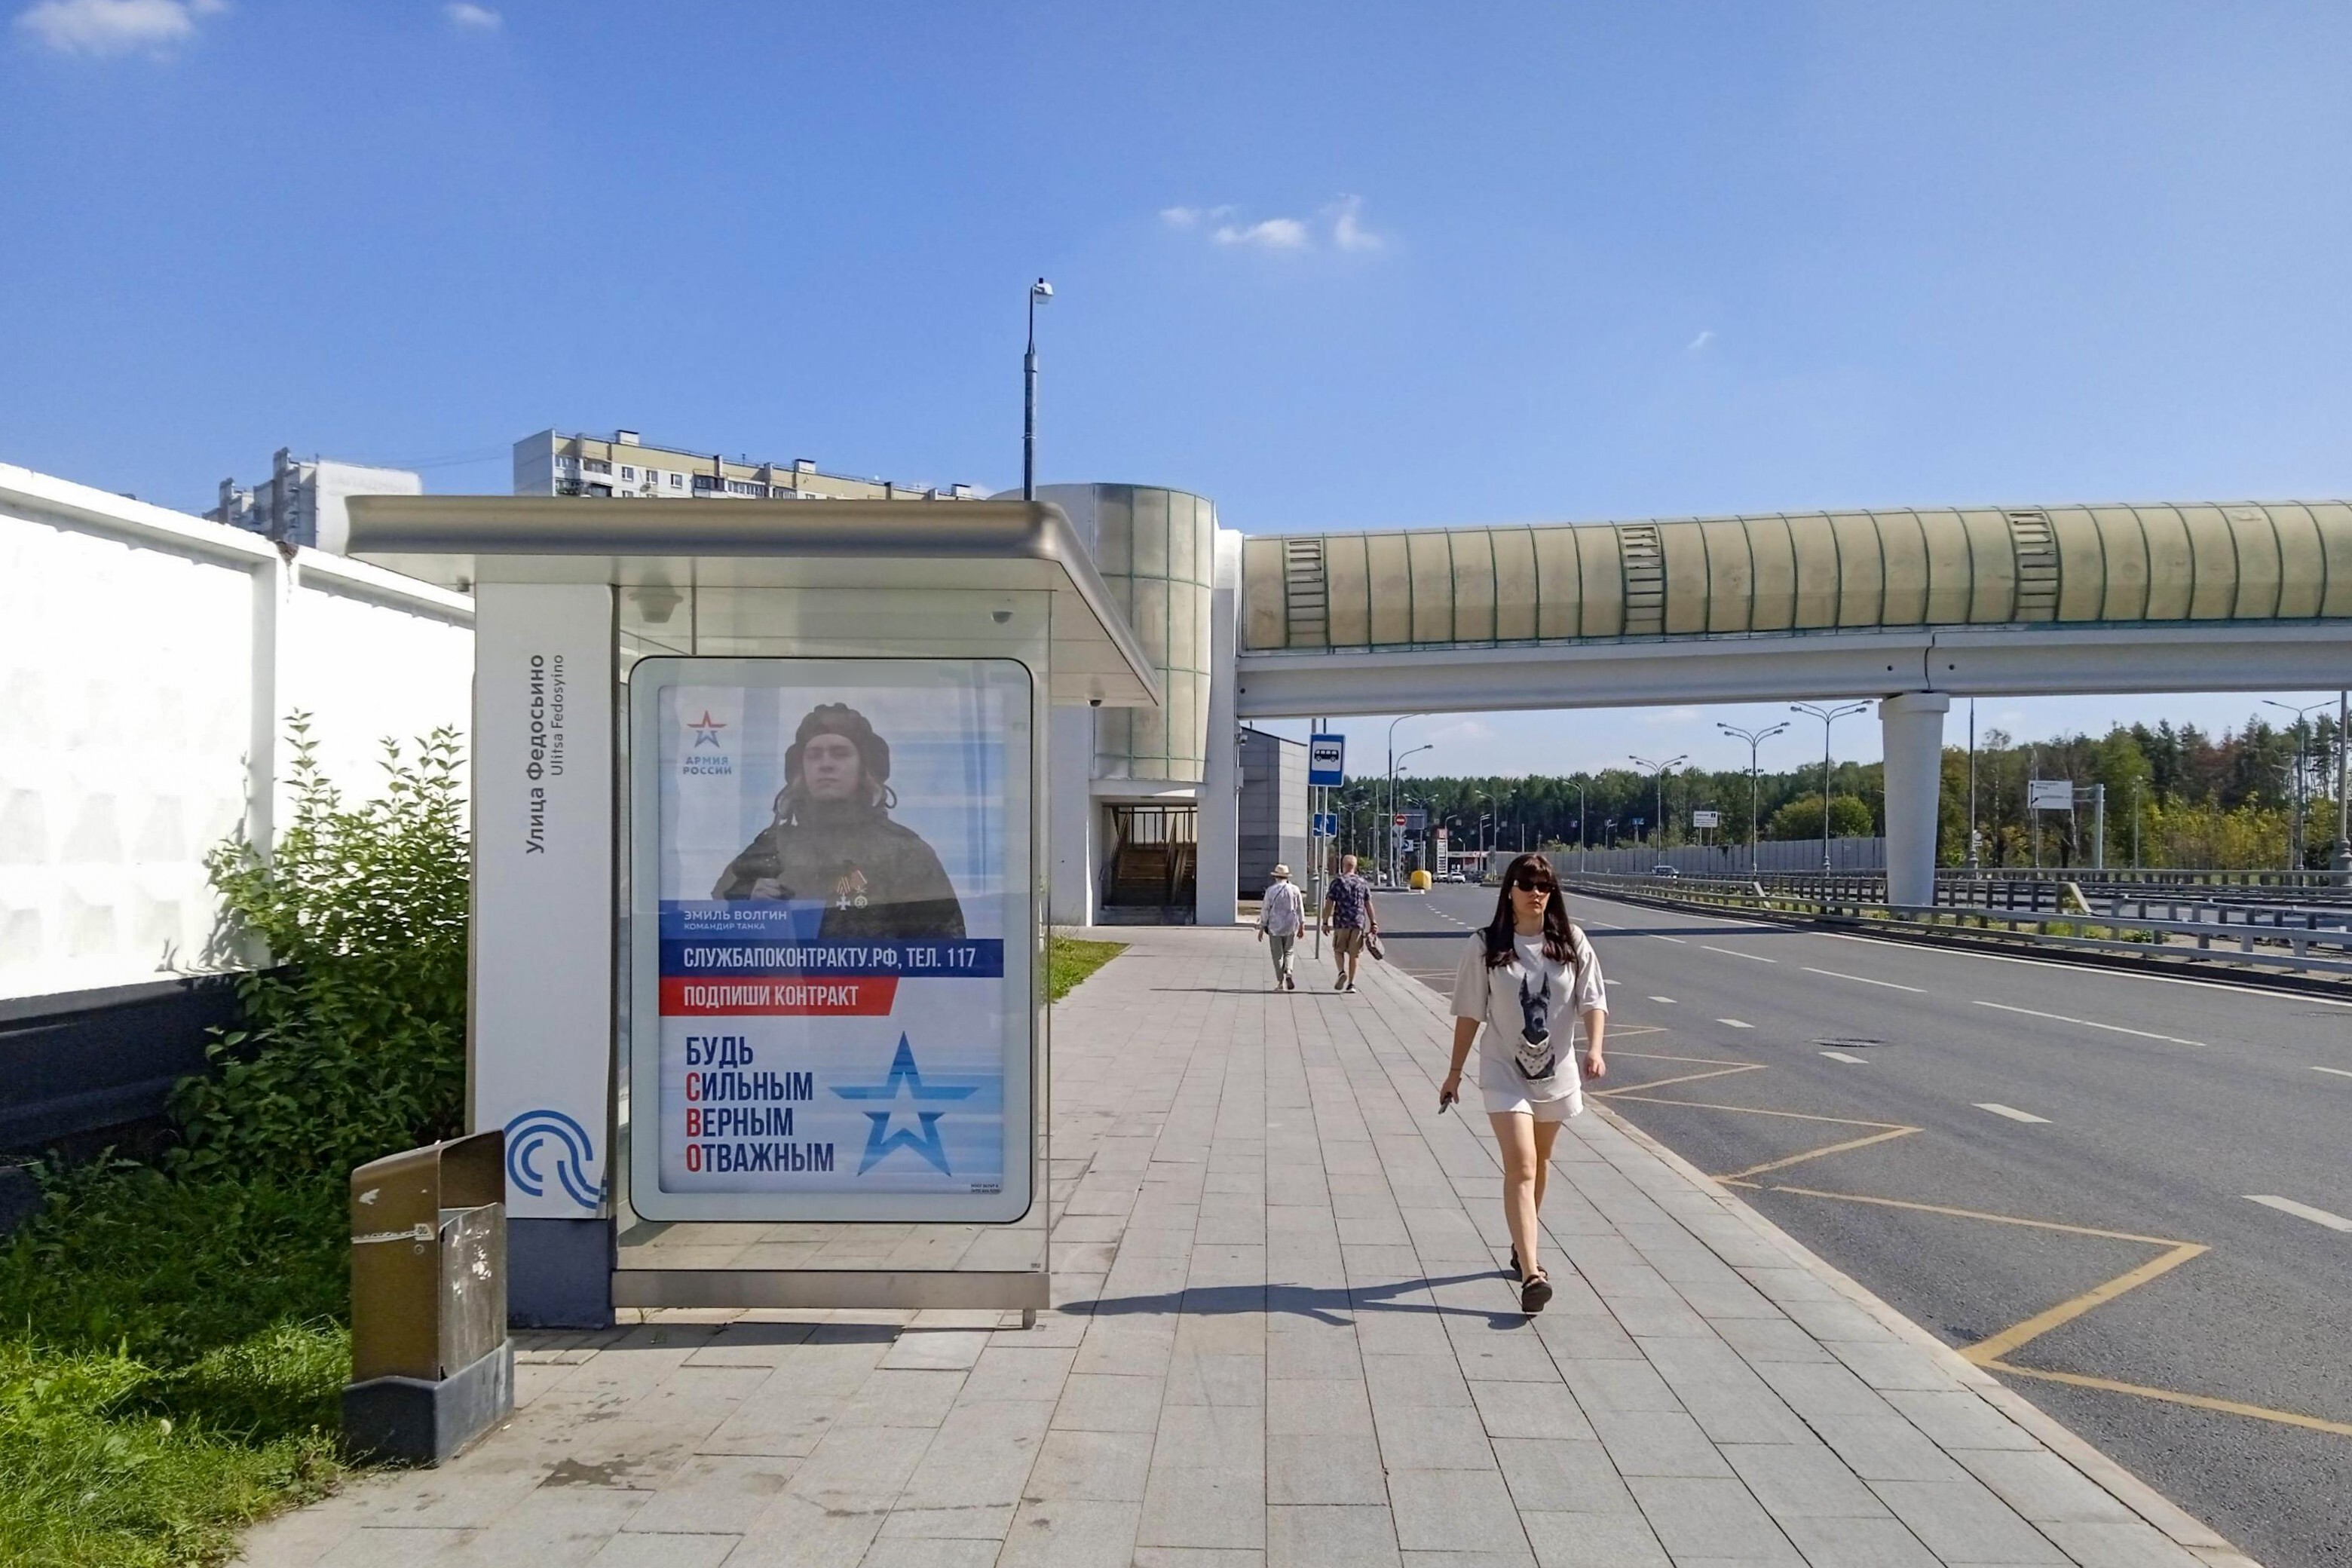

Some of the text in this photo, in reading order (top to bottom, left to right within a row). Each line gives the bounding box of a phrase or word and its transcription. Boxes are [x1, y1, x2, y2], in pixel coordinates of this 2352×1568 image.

[550, 654, 566, 776] Ulitsa Fedosyino
[525, 654, 547, 854] Улица Федосьино
[685, 756, 729, 765] АРМИЯ
[682, 766, 732, 775] РОССИИ
[684, 910, 787, 920] ЭМИЛЬ ВОЛГИН
[683, 947, 976, 969] СЛУЖБАПОКОНТРАКТУ.РФ, ТЕЛ. 117
[683, 985, 859, 1009] ПОДПИШИ КОНТРАКТ
[686, 1037, 754, 1069] БУДЬ
[686, 1072, 813, 1101] СИЛЬНЫМ
[686, 1107, 794, 1138] ВЕРНЫМ
[686, 1143, 835, 1173] ОТВАЖНЫМ
